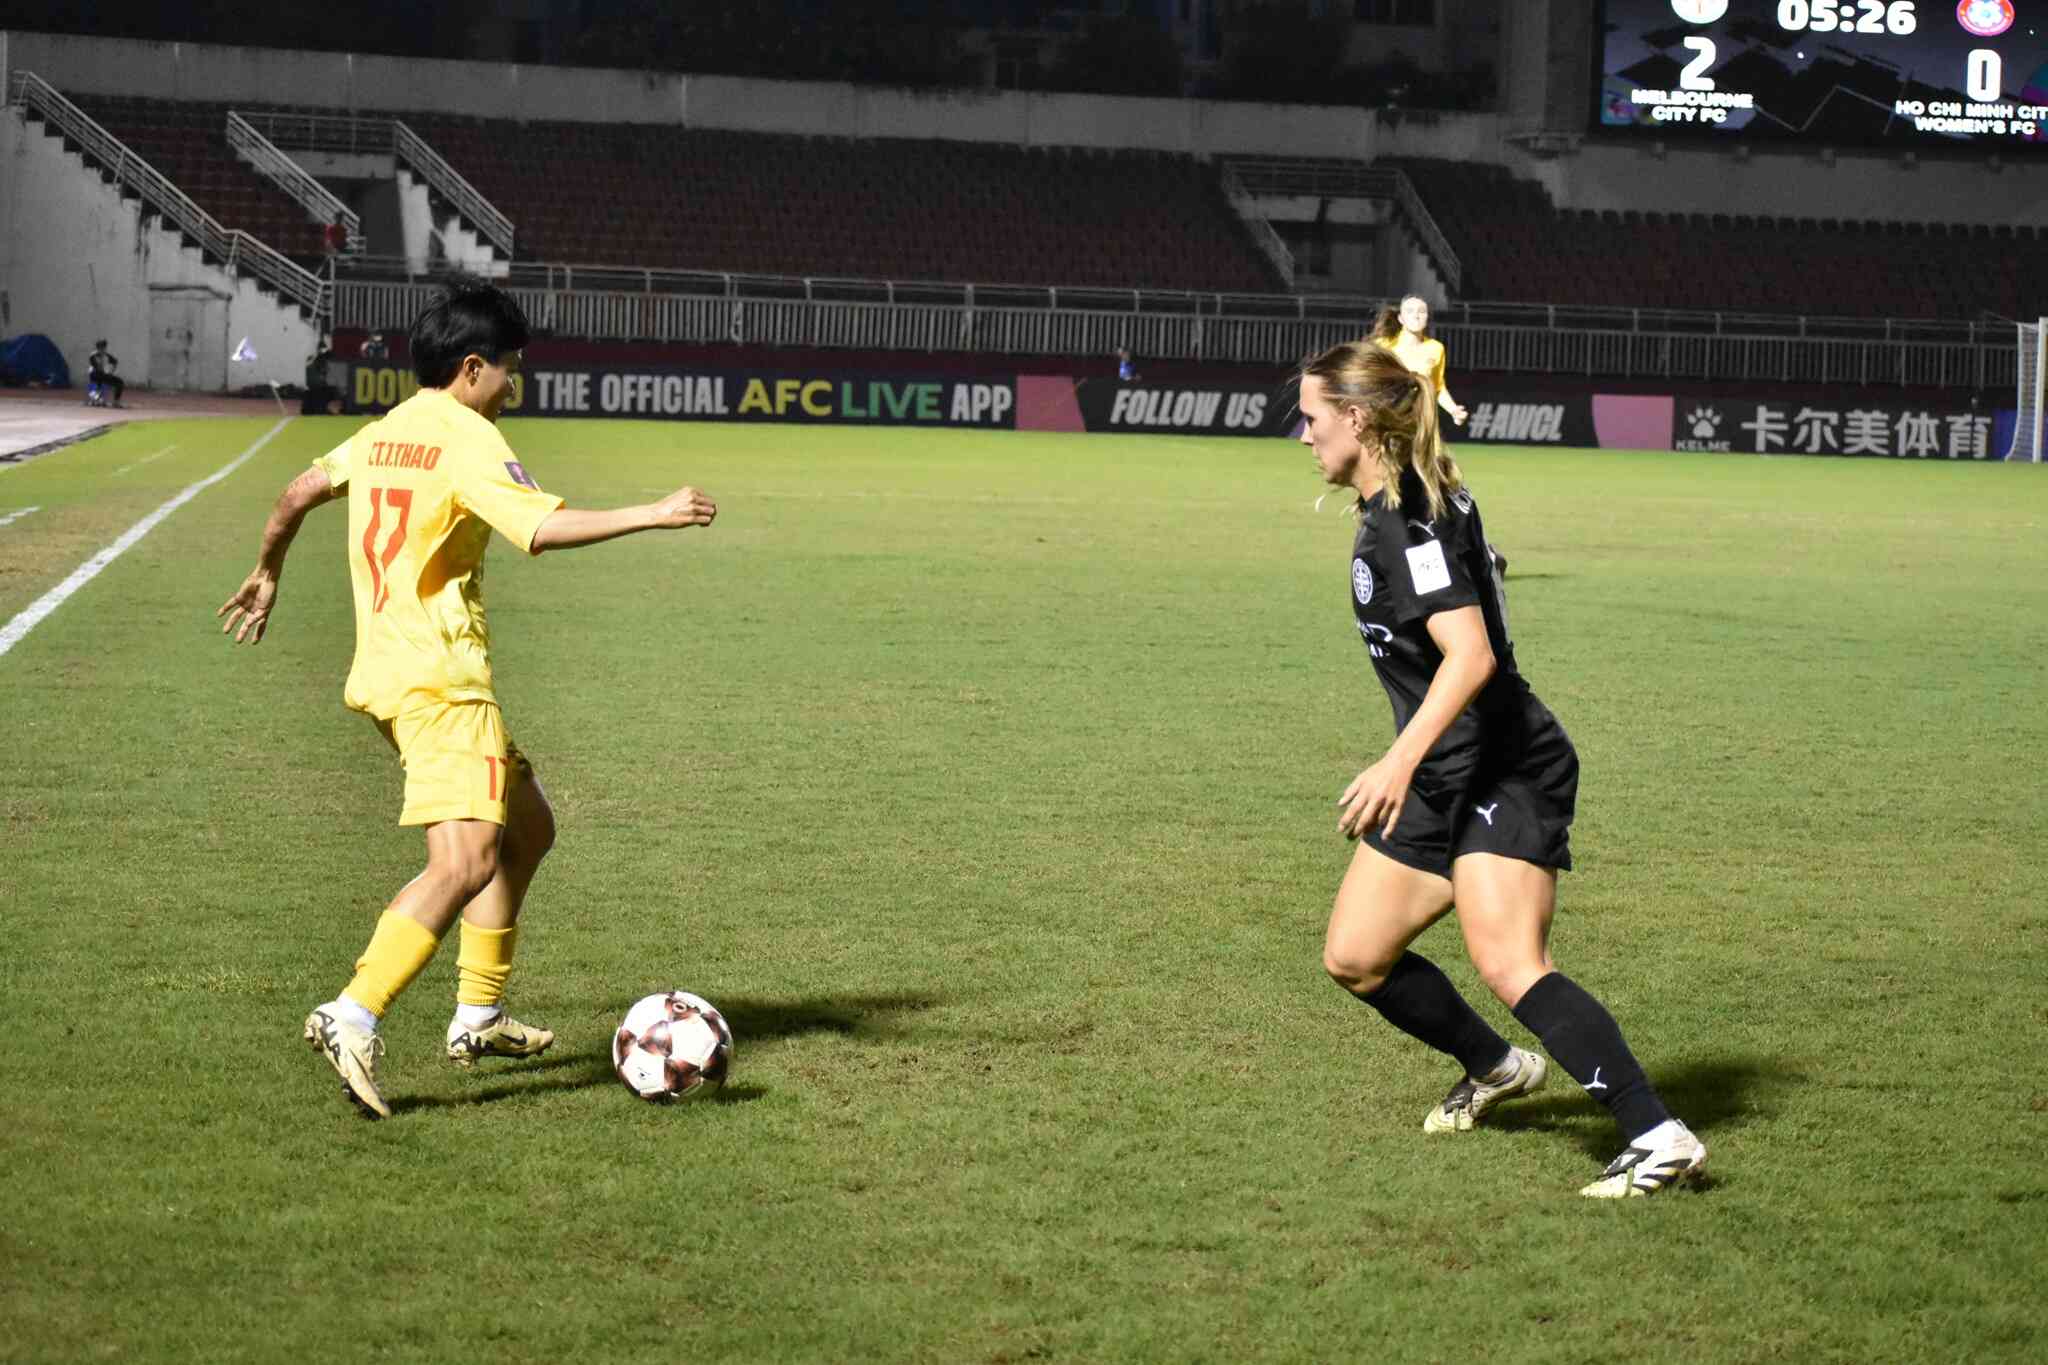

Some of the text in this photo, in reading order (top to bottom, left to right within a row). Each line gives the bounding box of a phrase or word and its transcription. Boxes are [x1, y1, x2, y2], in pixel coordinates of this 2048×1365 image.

[1776, 0, 1917, 36] 05:26
[1679, 36, 1717, 91] 2
[1966, 48, 2002, 102] 0
[1631, 88, 1753, 109] MELBOURNE
[1651, 105, 1727, 123] CITY FC
[1895, 100, 1925, 116] HO
[1928, 101, 1962, 117] CHI
[1965, 103, 2014, 119] MINH
[1914, 116, 2036, 135] WOMEN'S FC
[534, 371, 591, 412] THE
[599, 374, 729, 417] OFFICIAL
[737, 378, 833, 417] AFC
[841, 380, 944, 420] LIVE
[950, 383, 1013, 422] APP
[1109, 388, 1268, 429] FOLLOW US
[1468, 402, 1566, 441] #AWCL
[1740, 405, 1992, 459] 卡尔美体育
[362, 487, 414, 614] 17
